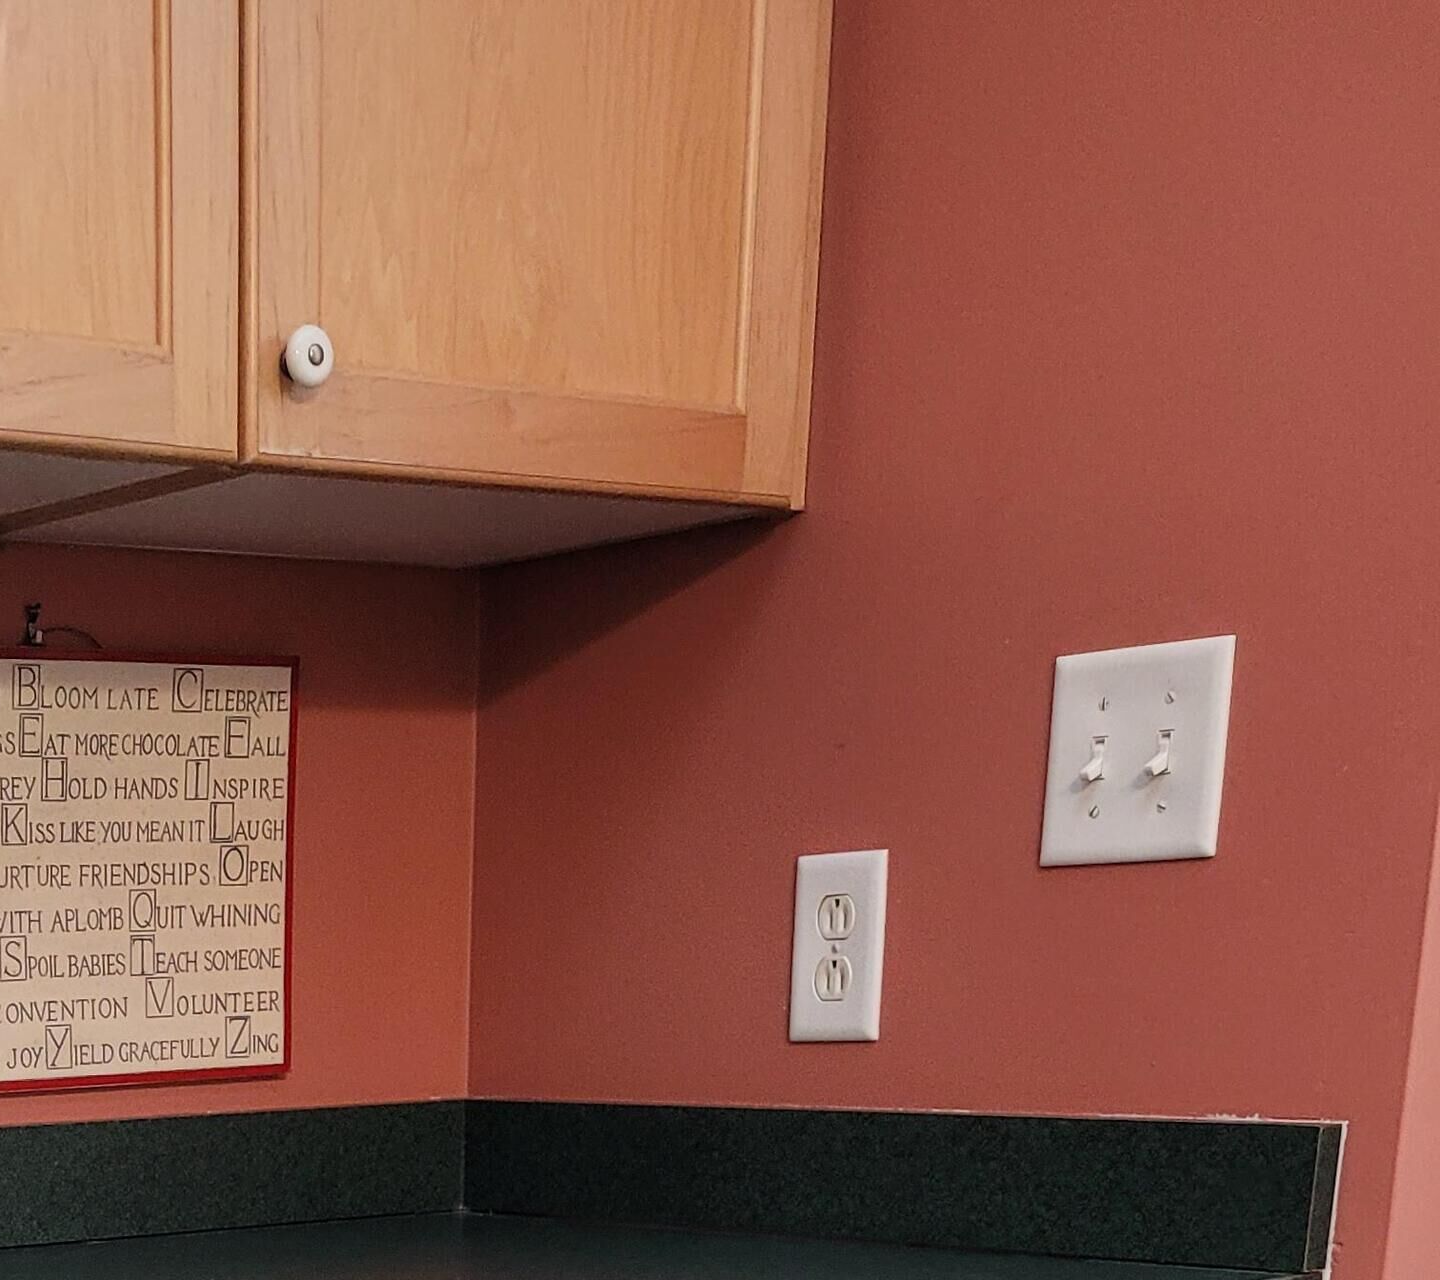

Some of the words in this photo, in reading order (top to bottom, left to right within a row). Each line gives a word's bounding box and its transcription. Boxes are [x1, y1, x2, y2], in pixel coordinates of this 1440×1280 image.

[17, 667, 98, 709] BLOOM
[107, 688, 159, 710] LATE
[177, 671, 288, 717] CELEBRATE
[22, 716, 71, 756] EAT
[76, 734, 118, 759] MORE
[122, 733, 220, 757] CHOCOLATE
[228, 720, 286, 757] FALL
[45, 760, 107, 799] HOLD
[115, 777, 178, 800] HANDS
[194, 762, 285, 800] INSPIRE
[4, 807, 55, 844] KISS
[60, 821, 96, 843] LIKE
[100, 822, 131, 843] YOU
[137, 821, 184, 843] MEAN
[190, 821, 205, 843] IT
[213, 805, 284, 842] LAUGH
[223, 847, 283, 882] OPEN
[51, 908, 123, 932] APLOMB
[133, 892, 186, 928] QUIT
[191, 904, 280, 927] WHINING
[4, 941, 64, 978] SPOIL
[69, 953, 125, 978] BABIES
[133, 939, 197, 975] TEACH
[204, 948, 281, 971] SOMEONE
[149, 980, 280, 1016] VOLUNTEER
[6, 1044, 43, 1069] JOY
[47, 1028, 114, 1066] YIELD
[119, 1037, 220, 1062] GRACEFULLY
[229, 1018, 279, 1054] ZING
